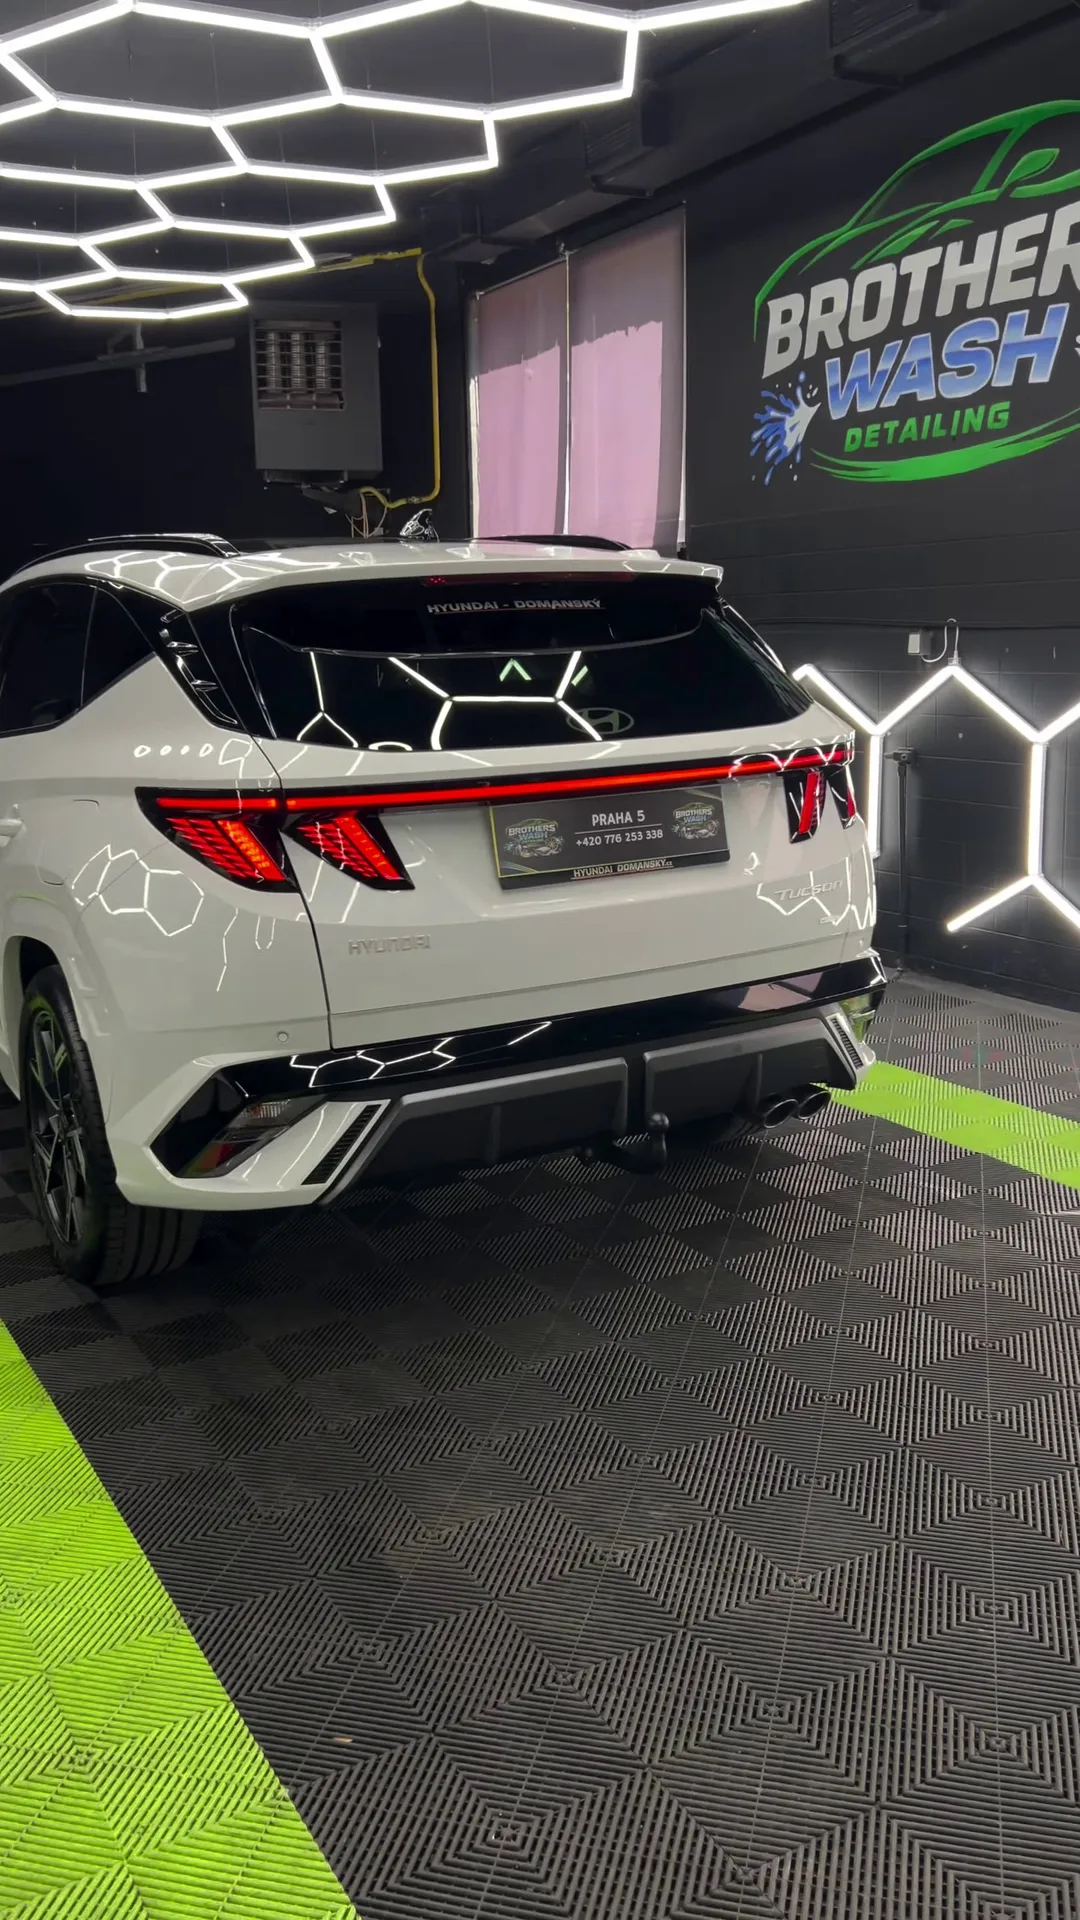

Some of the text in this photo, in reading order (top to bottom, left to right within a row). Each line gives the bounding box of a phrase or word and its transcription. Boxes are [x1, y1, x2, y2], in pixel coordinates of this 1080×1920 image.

[825, 303, 1070, 420] WASH
[844, 401, 1011, 452] DETAILING
[427, 601, 499, 613] HYUNDAI
[591, 810, 646, 827] PRAHA 5
[675, 808, 713, 819] BROTHERS
[683, 815, 707, 823] WASH
[508, 824, 556, 837] BROTHERS
[518, 832, 548, 841] WASH
[575, 829, 664, 847] +420 776 253 338
[573, 866, 613, 878] HYUNDAI
[348, 934, 431, 955] HYUNDAI
